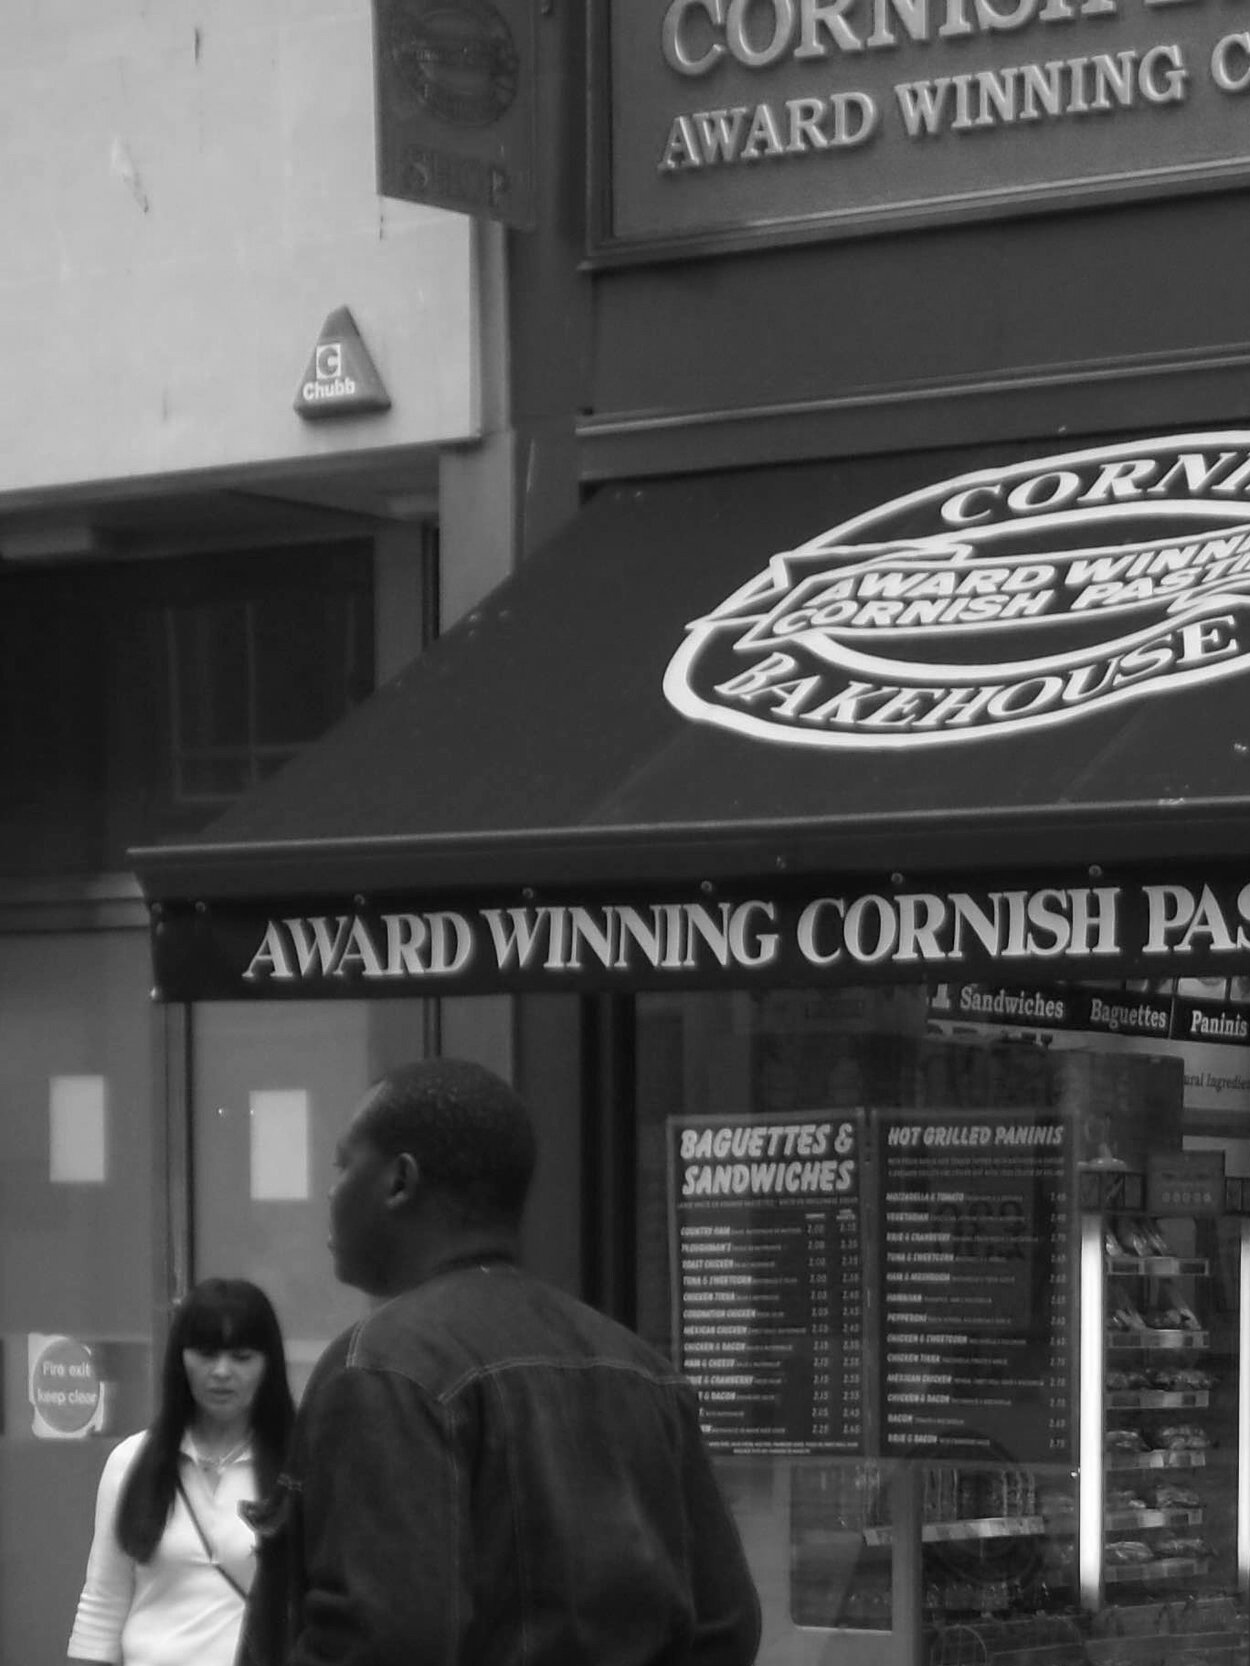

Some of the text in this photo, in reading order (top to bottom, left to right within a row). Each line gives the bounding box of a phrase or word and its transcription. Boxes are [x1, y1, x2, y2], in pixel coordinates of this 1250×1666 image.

[657, 91, 878, 172] AWARD
[894, 44, 1188, 138] WINNING
[303, 378, 356, 401] Chubb
[804, 562, 1055, 606] AWARD
[772, 589, 1055, 632] CORNISH
[712, 614, 1240, 731] BAKEHOUSE
[242, 911, 473, 978] AWARD
[479, 900, 779, 970] WINNING
[796, 886, 1122, 966] CORNISH
[960, 985, 1065, 1020] Sandwiches
[1089, 998, 1168, 1031] Baguettes
[1190, 1009, 1250, 1037] Paninis
[680, 1121, 854, 1160] BAGUETTES &
[887, 1125, 1064, 1148] HOT GRILLED PANINIS
[681, 1159, 856, 1197] SANDWICHES
